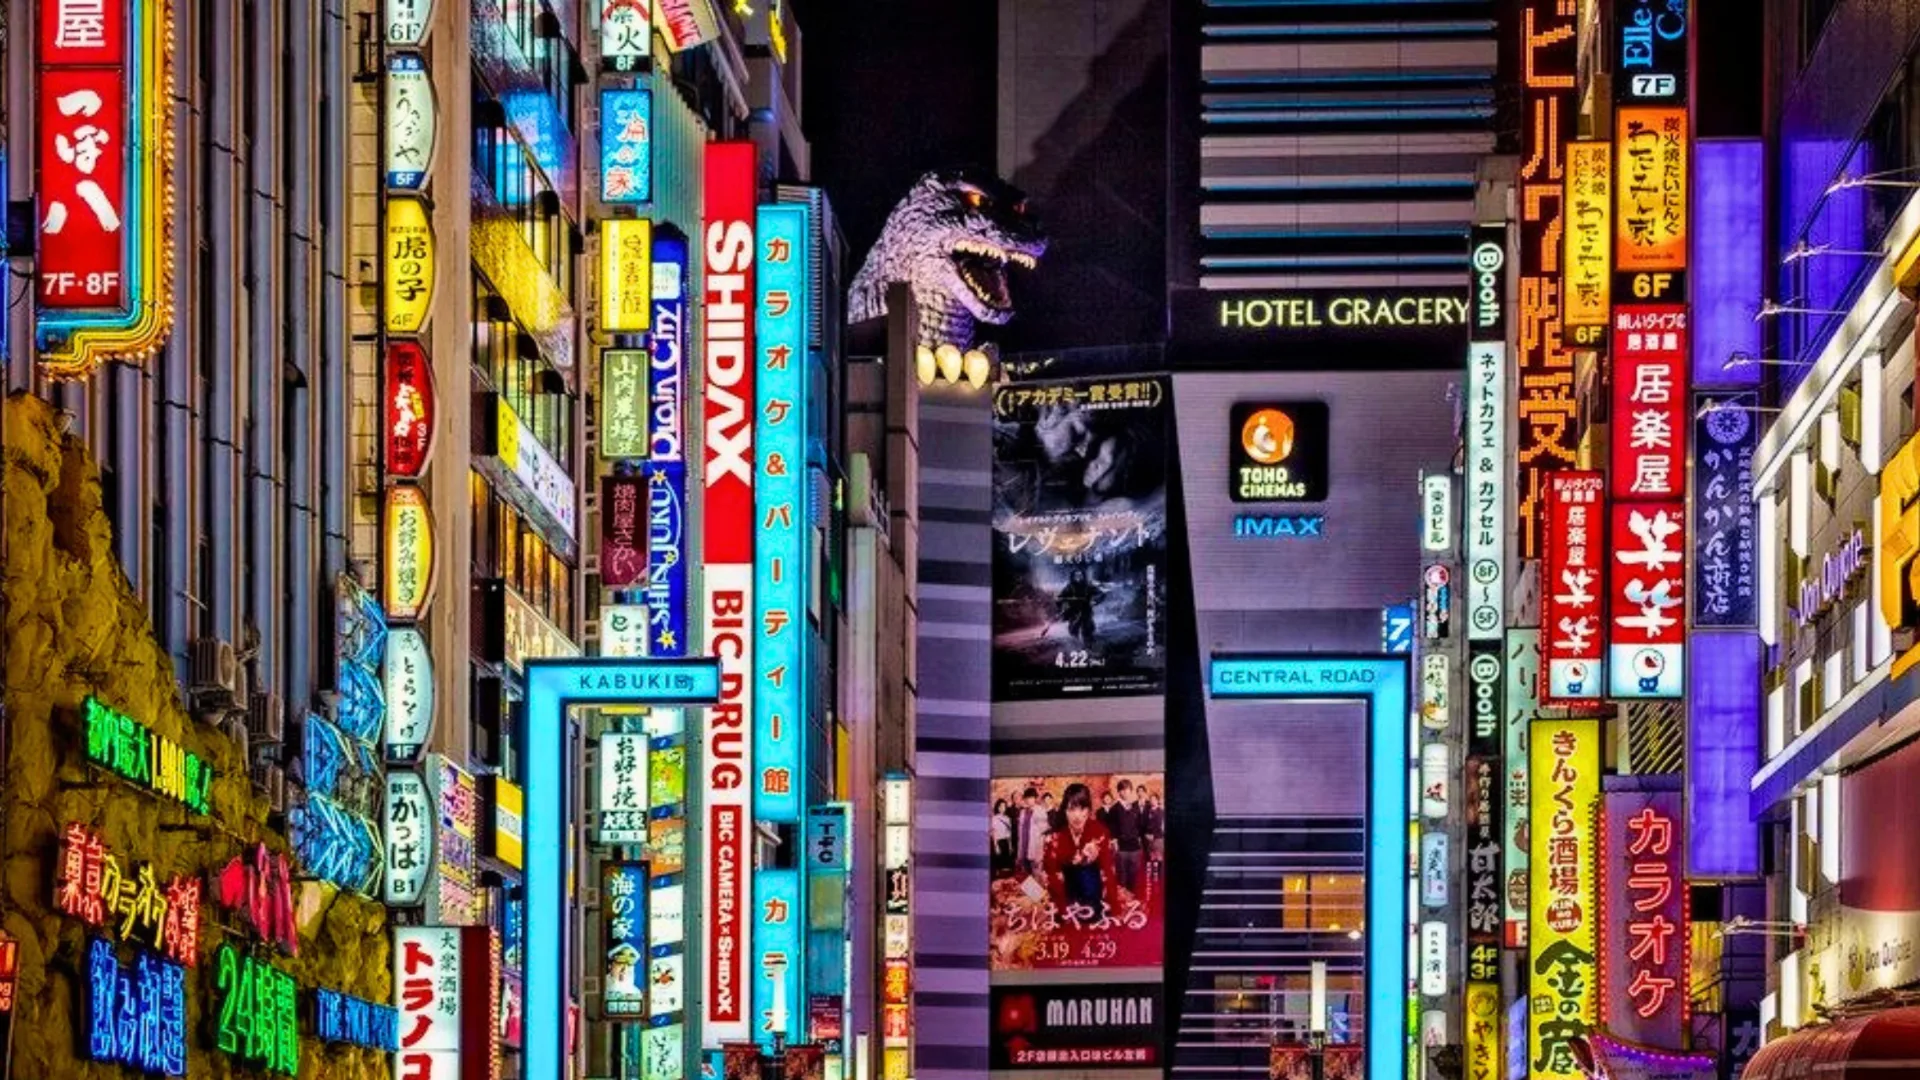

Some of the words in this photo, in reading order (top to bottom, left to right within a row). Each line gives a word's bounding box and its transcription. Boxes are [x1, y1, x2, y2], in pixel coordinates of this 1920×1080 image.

[389, 22, 421, 42] 6F
[1623, 8, 1652, 69] Elle
[1638, 77, 1672, 95] 7F
[393, 236, 428, 302] 虎の子
[1472, 242, 1503, 328] Booth
[1633, 273, 1673, 299] 6F
[1220, 299, 1322, 328] HOTEL
[1327, 297, 1469, 326] GRACERY
[1574, 326, 1602, 344] 6F
[707, 220, 753, 489] SHIDAX
[1477, 353, 1497, 448] ネットカフェ
[1630, 363, 1674, 493] 居楽屋
[1239, 466, 1289, 483] TOHO
[1478, 458, 1496, 473] &
[1239, 482, 1306, 499] CINEMAS
[1234, 516, 1325, 538] IMAX
[1477, 482, 1497, 547] カプセル
[711, 590, 743, 663] BIC
[1055, 651, 1090, 668] 4.22
[1219, 671, 1313, 686] CENTRAL
[1320, 670, 1376, 686] ROAD
[1470, 653, 1501, 738] Booth
[711, 666, 743, 791] DRUG
[394, 743, 416, 759] 1F
[717, 810, 735, 840] BIC
[1549, 730, 1580, 895] きんくら酒場
[392, 878, 417, 893] B1
[611, 872, 636, 941] 海の家
[1004, 900, 1149, 931] ちはやふる
[1628, 809, 1677, 1026] カラオケ
[1036, 941, 1070, 961] 3.19
[1081, 940, 1117, 959] 4.29
[1471, 946, 1497, 965] 4F
[1471, 965, 1497, 980] 3F
[218, 945, 298, 1076] 24時間
[1047, 997, 1153, 1025] MARUHAN
